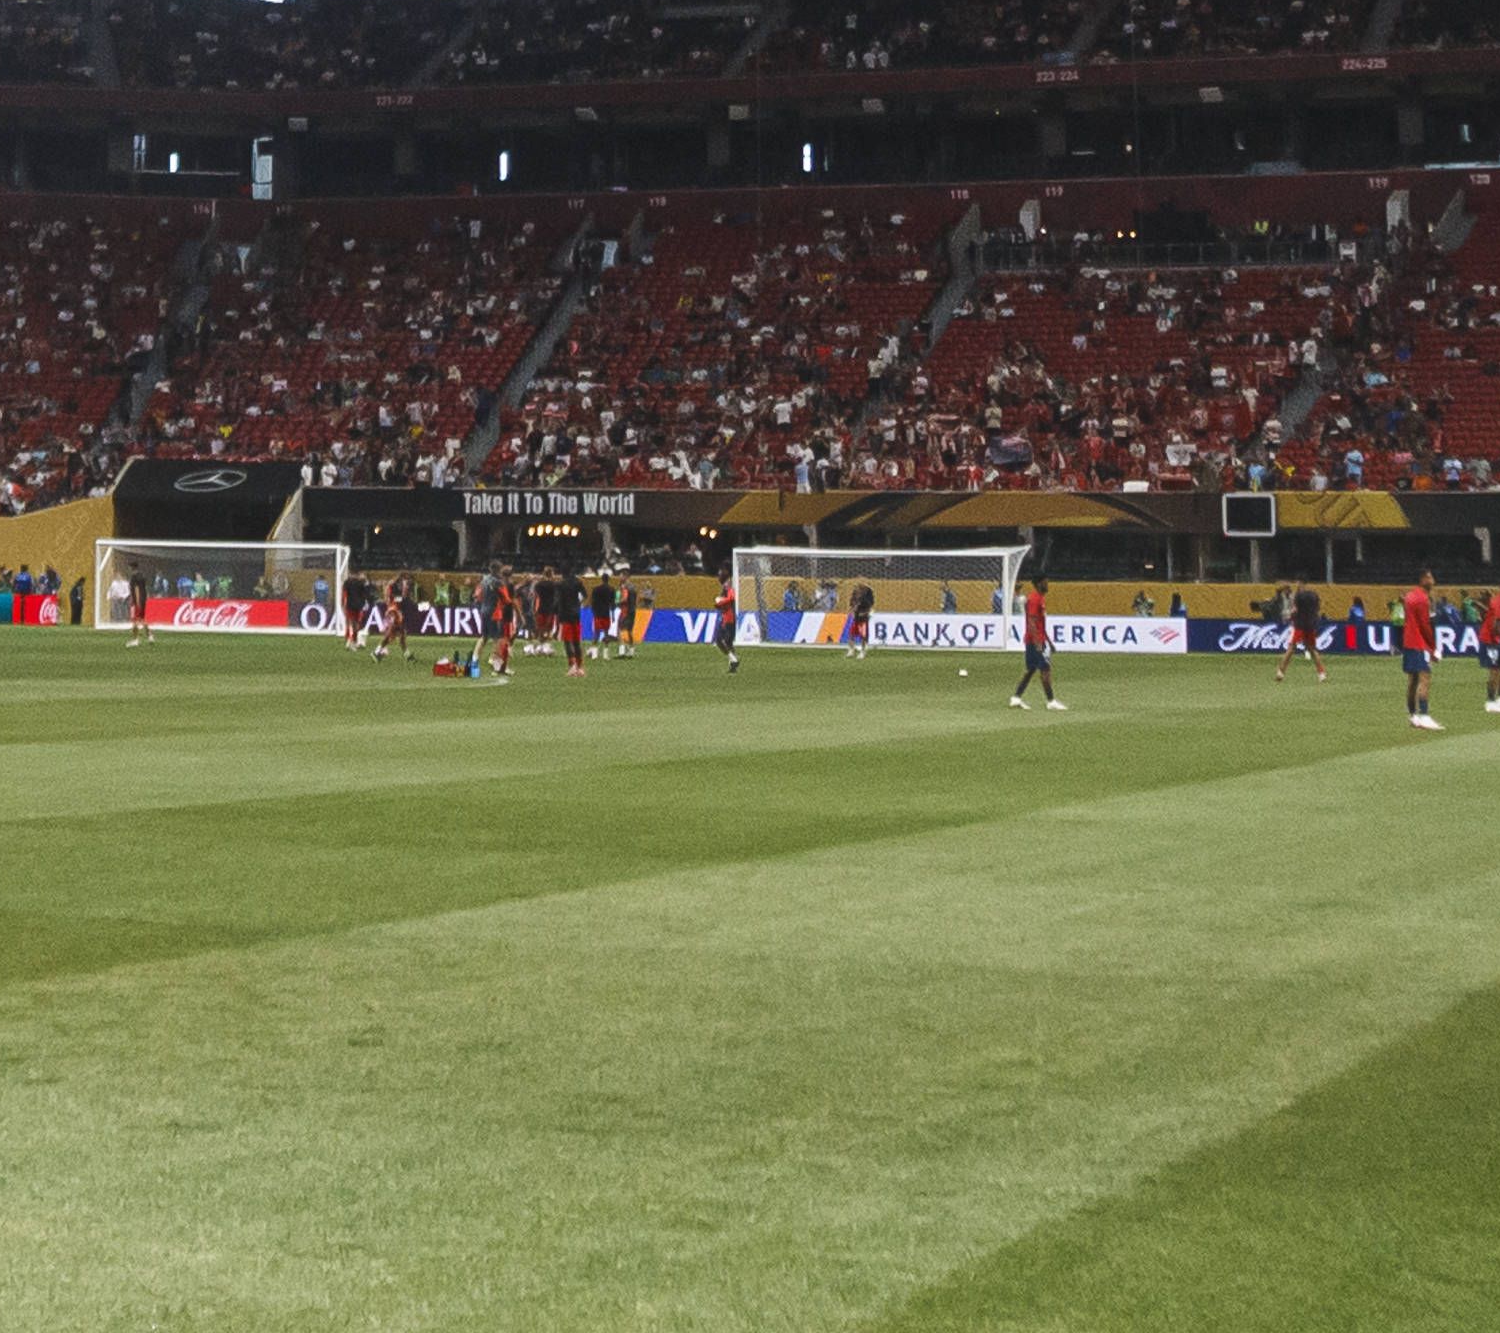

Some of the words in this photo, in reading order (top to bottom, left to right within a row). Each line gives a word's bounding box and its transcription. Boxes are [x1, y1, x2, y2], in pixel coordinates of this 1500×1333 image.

[463, 492, 504, 515] Take
[524, 493, 544, 515] To
[548, 492, 578, 515] The
[583, 492, 635, 515] World
[676, 612, 762, 645] VIA
[873, 622, 956, 645] BANK
[961, 622, 996, 645] OF
